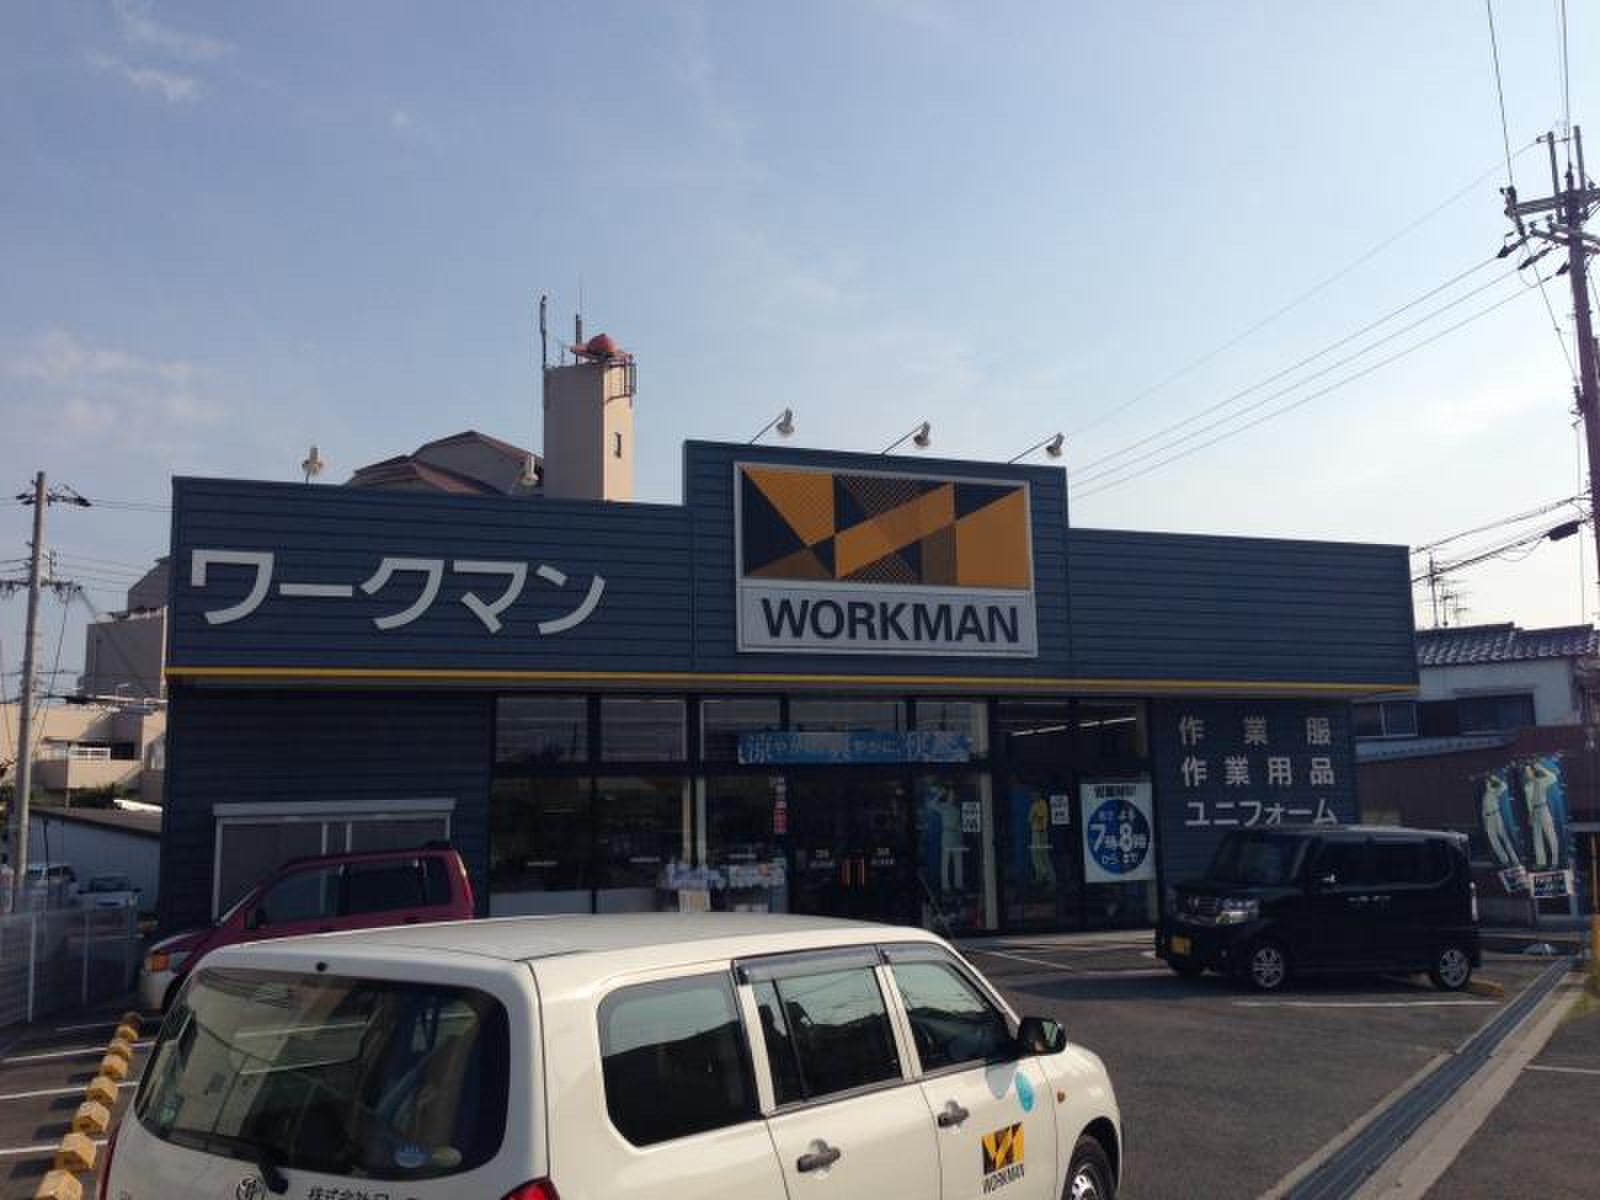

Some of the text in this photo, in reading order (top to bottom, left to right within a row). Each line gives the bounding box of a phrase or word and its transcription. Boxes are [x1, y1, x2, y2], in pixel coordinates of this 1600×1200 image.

[191, 549, 605, 635] ワークマン
[761, 598, 1019, 643] WORKMAN
[1178, 715, 1332, 746] 作業服
[1181, 754, 1336, 787] 作業用品
[1185, 798, 1338, 827] ユニフォーム
